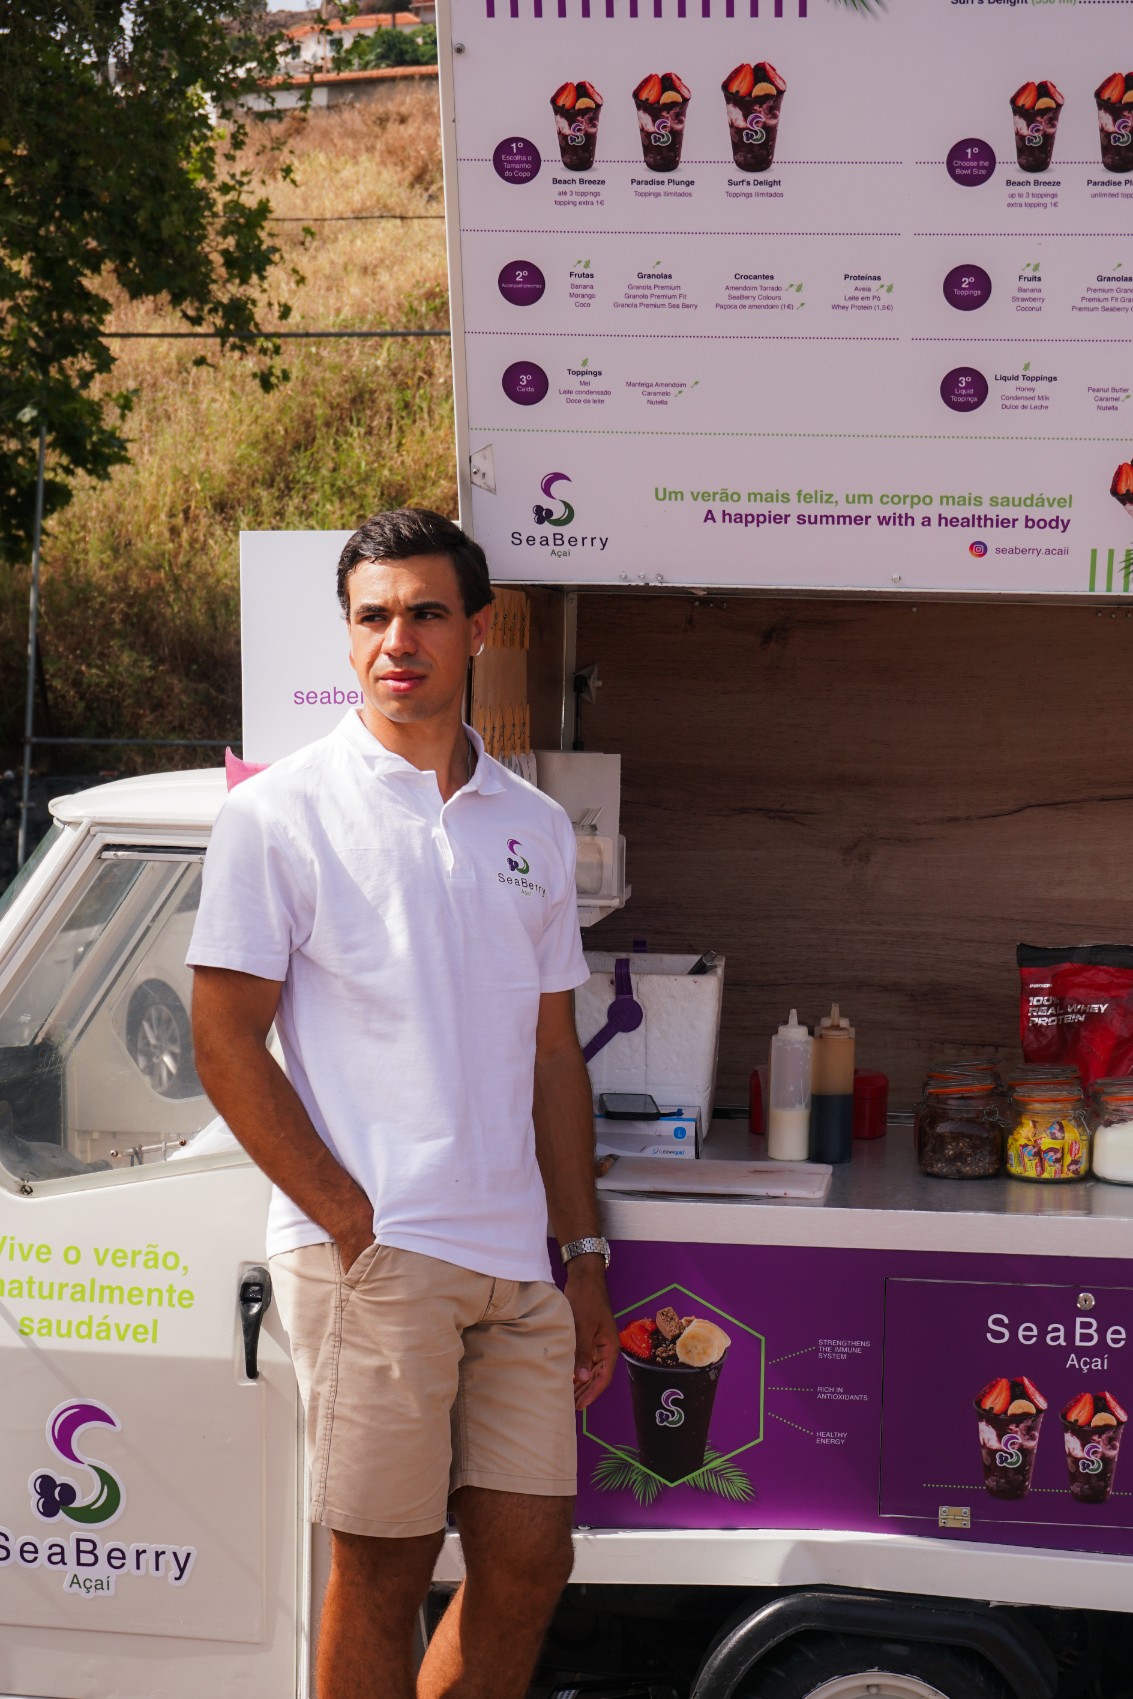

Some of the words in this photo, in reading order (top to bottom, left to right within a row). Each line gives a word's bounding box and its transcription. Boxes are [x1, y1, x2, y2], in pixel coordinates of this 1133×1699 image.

[668, 179, 695, 187] Plunge
[567, 369, 602, 377] Toppings
[655, 487, 684, 502] Um
[691, 489, 741, 502] verão
[747, 490, 790, 504] mais
[796, 490, 838, 507] feliz,
[845, 493, 872, 505] um
[880, 494, 933, 509] corpo
[940, 493, 983, 507] mais
[989, 493, 1073, 508] saudável
[704, 510, 716, 523] A
[722, 510, 791, 527] happier
[796, 513, 871, 526] summer
[877, 512, 915, 527] with
[921, 517, 931, 527] a
[938, 514, 1019, 529] healthier
[1025, 515, 1071, 533] body
[511, 532, 608, 550] SeaBerry
[995, 545, 1069, 556] seaberry.acaii
[498, 872, 546, 897] SeaBerry
[1028, 1006, 1064, 1016] REAL
[1068, 1004, 1109, 1013] WHEY
[1029, 1014, 1086, 1026] PROTEIN
[63, 1245, 81, 1265] o
[93, 1244, 189, 1276] verão,
[18, 1315, 158, 1344] saudável
[986, 1314, 1127, 1348] SeaBe
[1066, 1354, 1108, 1373] Açaí
[69, 1574, 110, 1593] Açaí
